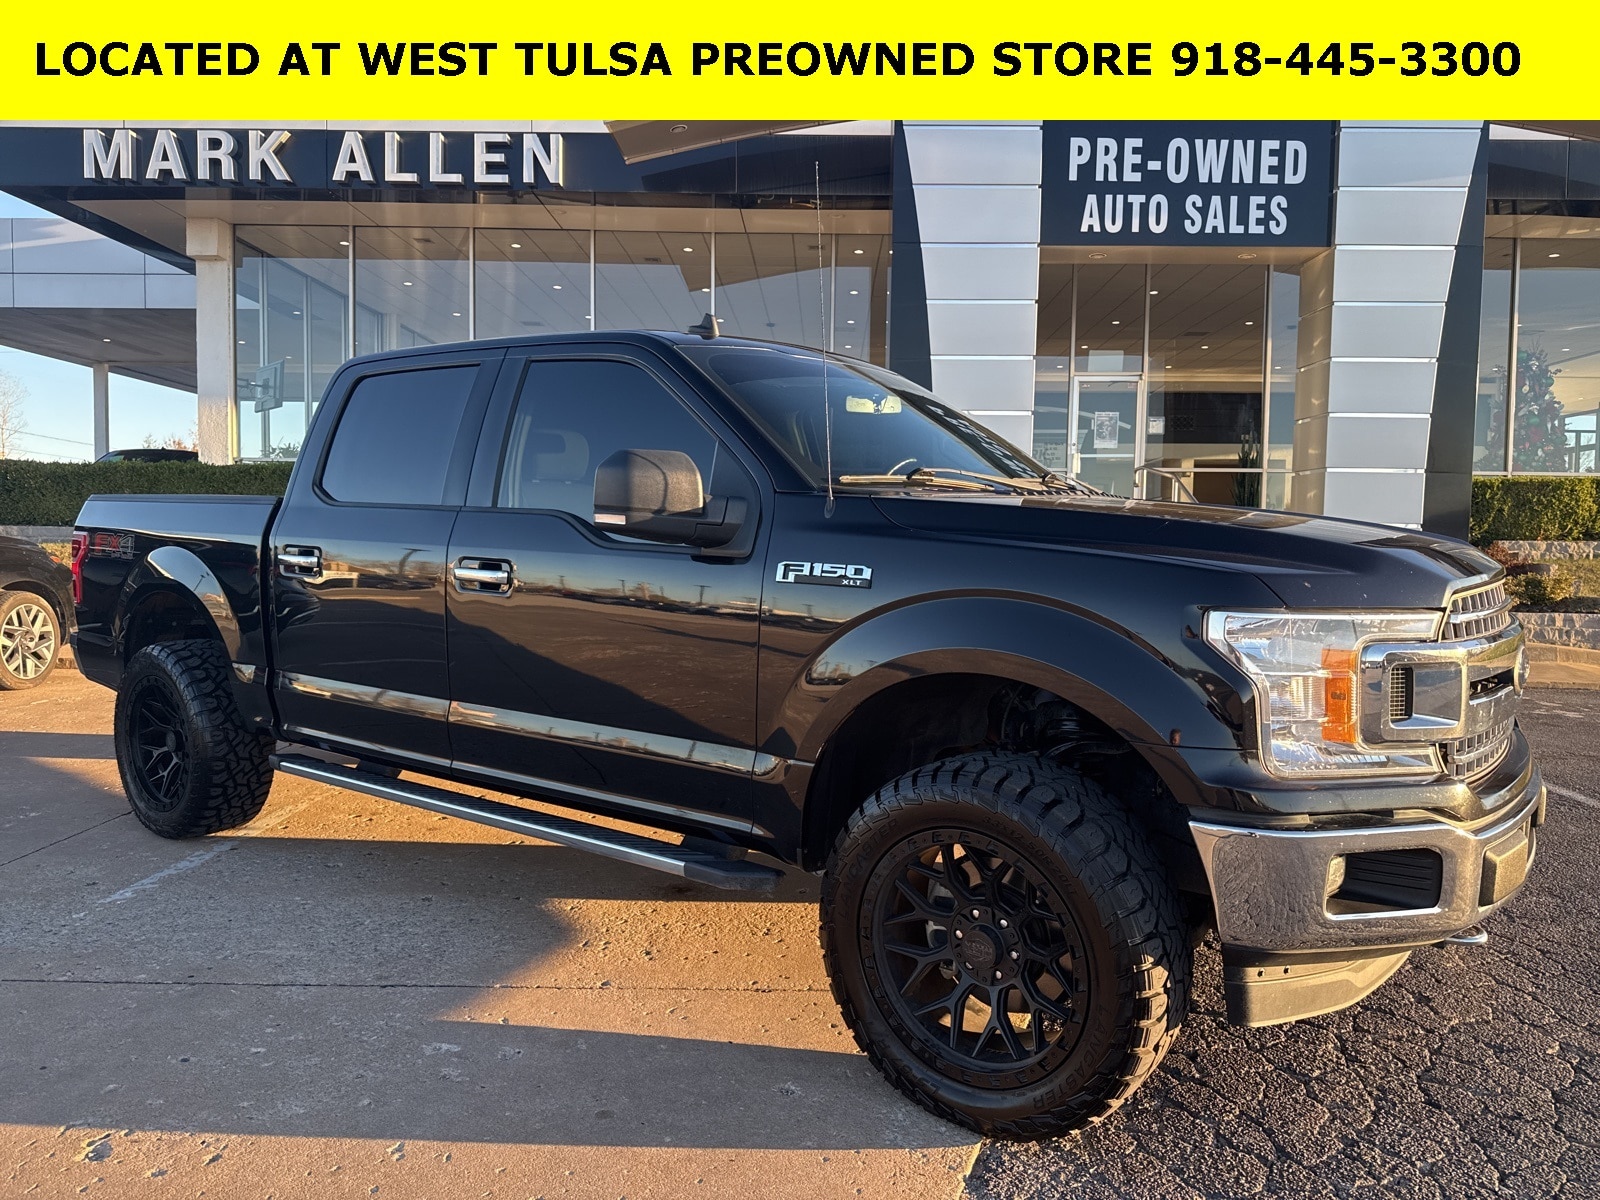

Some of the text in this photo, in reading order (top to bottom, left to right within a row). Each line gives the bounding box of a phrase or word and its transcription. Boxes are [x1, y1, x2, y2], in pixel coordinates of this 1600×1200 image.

[82, 128, 565, 187] MARK ALLEN
[1068, 137, 1308, 184] PRE-OWNED
[1080, 194, 1288, 234] AUTO SALES
[95, 532, 135, 555] FX4
[776, 560, 873, 583] F150
[1031, 1004, 1113, 1110] LANCASTER
